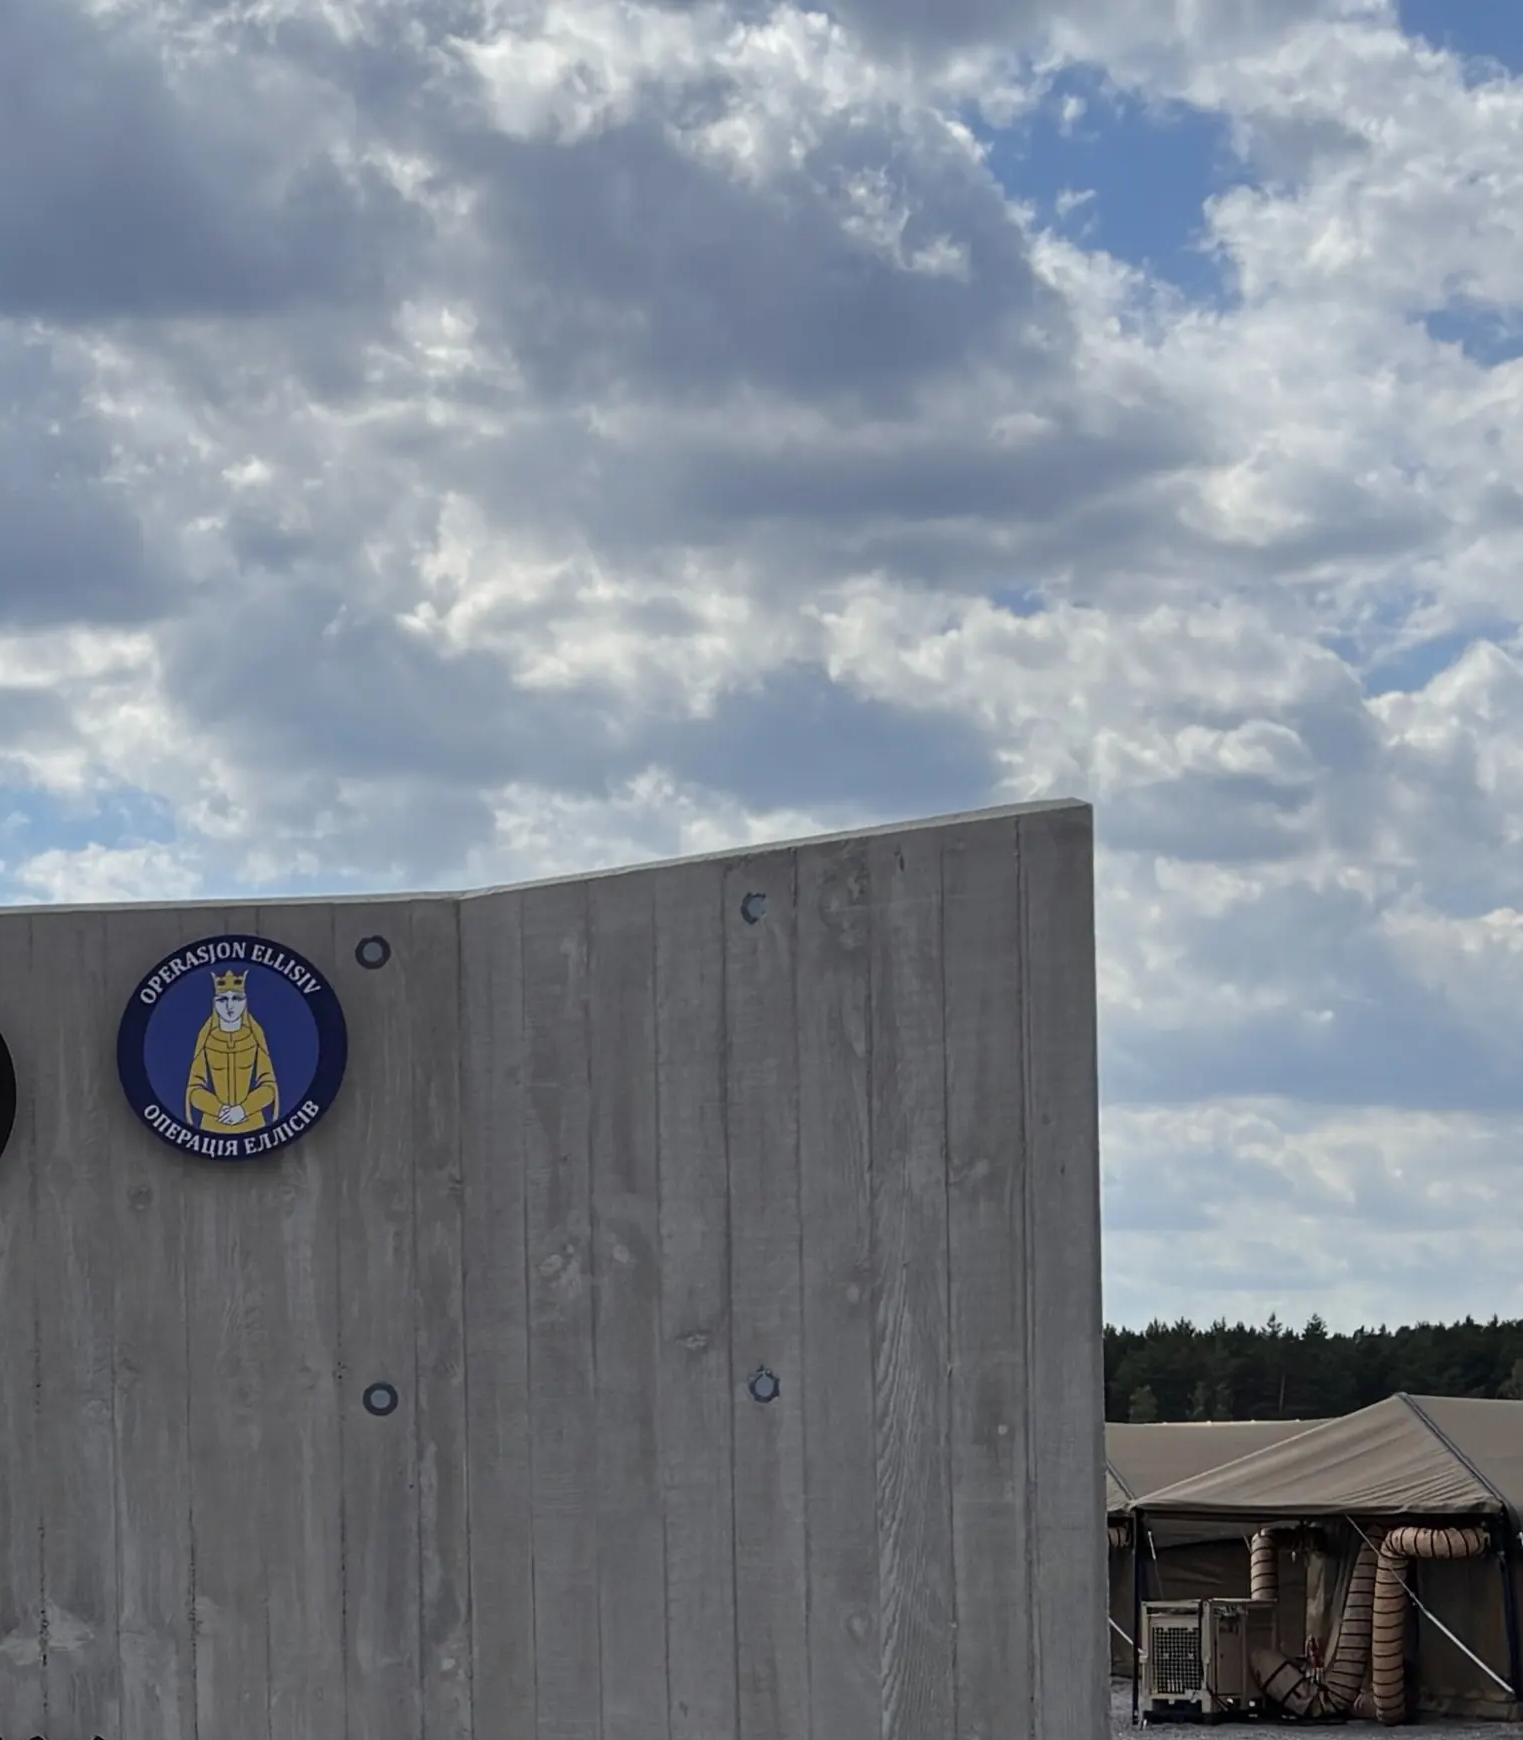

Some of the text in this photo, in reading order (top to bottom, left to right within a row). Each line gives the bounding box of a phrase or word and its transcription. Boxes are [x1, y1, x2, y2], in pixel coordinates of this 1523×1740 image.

[140, 941, 322, 1004] OPERASJON ELLISIV
[143, 1099, 320, 1158] ОПЕРАЦІЯ ЕЛЛІСІВ
